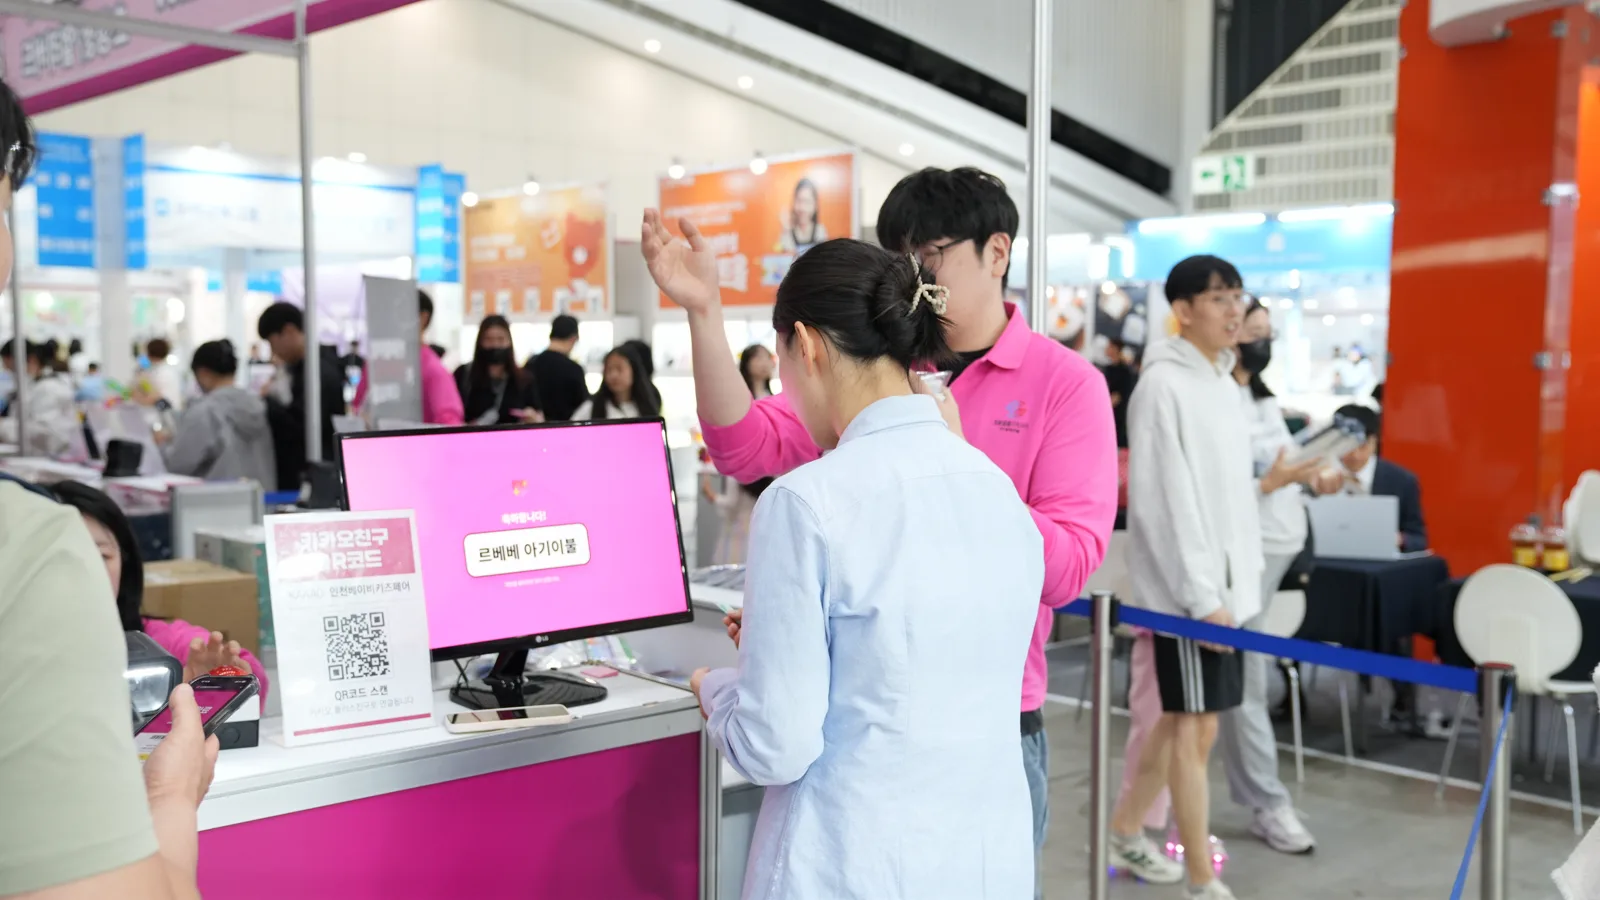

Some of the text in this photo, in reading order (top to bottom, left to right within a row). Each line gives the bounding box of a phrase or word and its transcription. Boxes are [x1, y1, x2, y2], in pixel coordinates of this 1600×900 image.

[322, 549, 383, 571] R코드
[479, 538, 577, 563] 르베베 아기이불
[329, 581, 411, 598] 인천베이비키즈페어
[334, 685, 388, 701] QR코드 스캔
